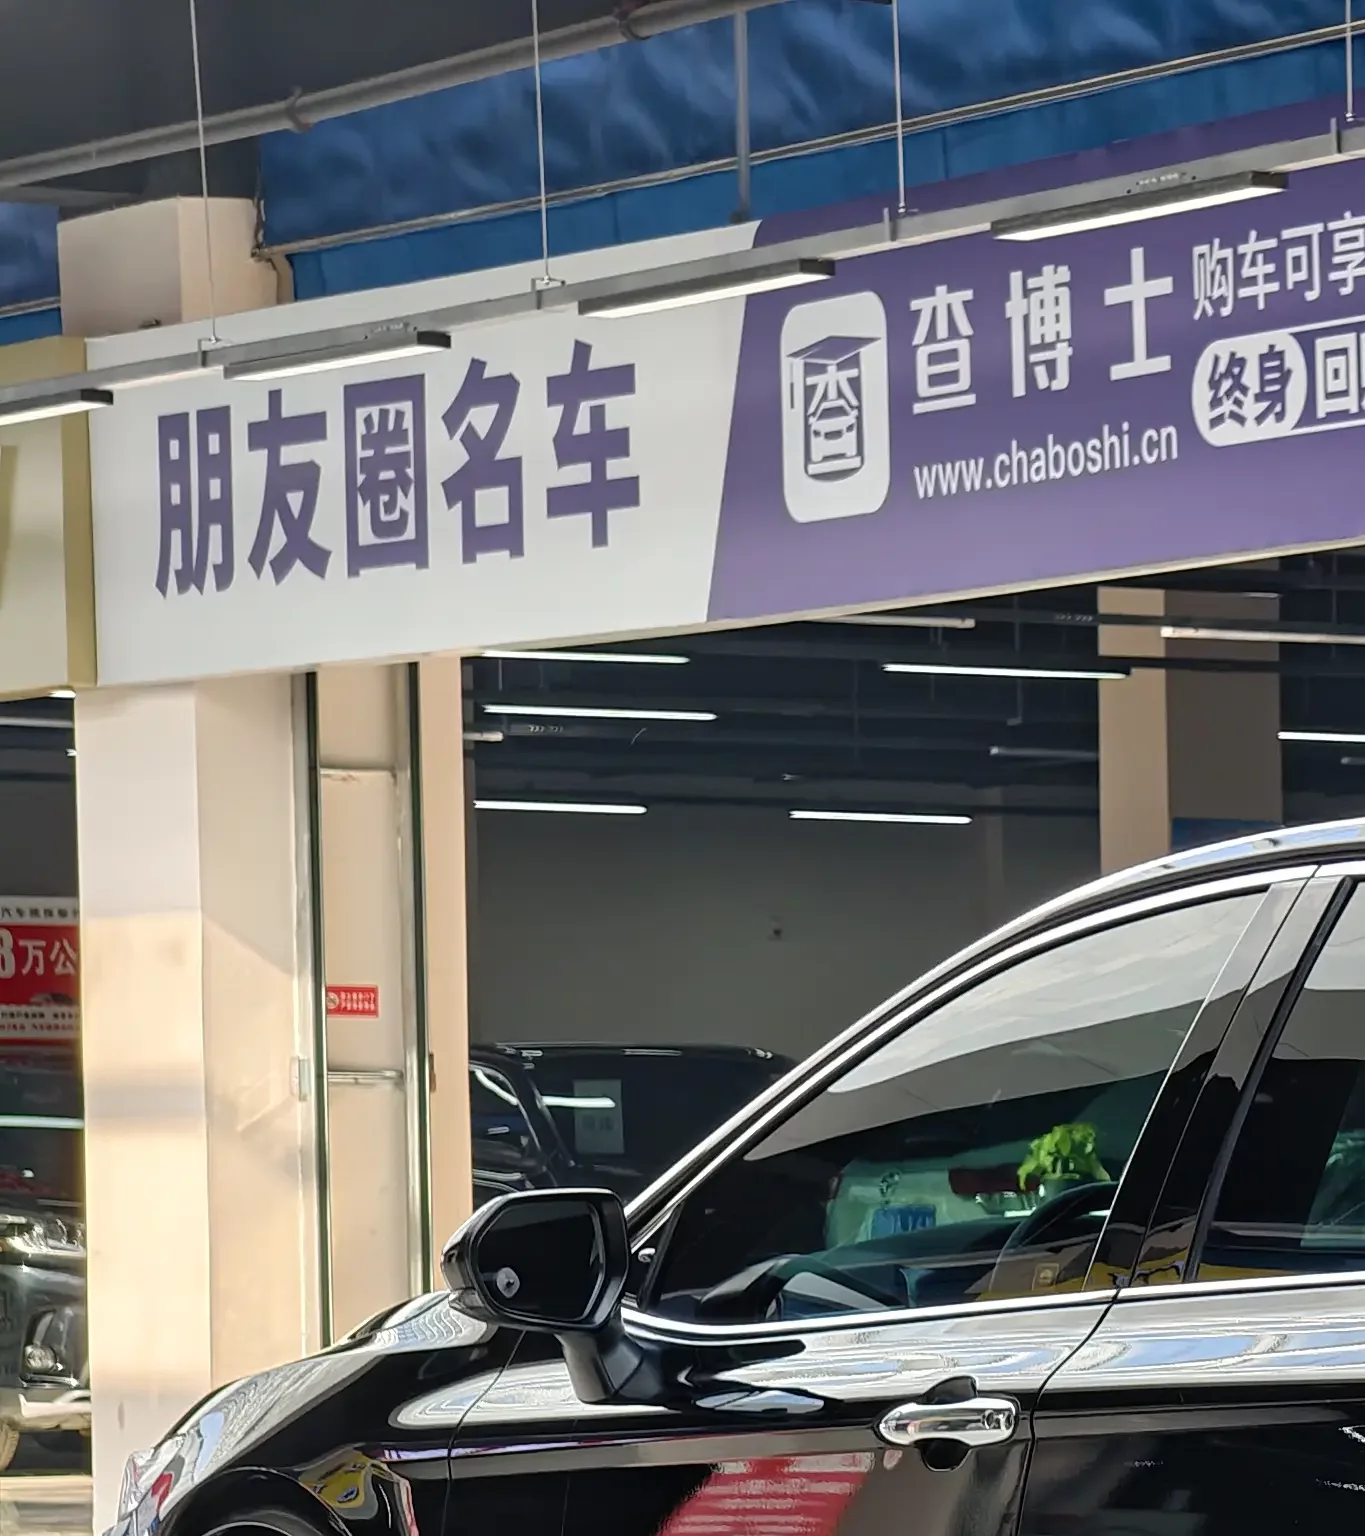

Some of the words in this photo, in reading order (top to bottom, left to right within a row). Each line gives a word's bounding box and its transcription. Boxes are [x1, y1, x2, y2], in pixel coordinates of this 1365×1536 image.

[910, 247, 1173, 415] 查博士
[1209, 344, 1292, 431] 终身
[155, 340, 640, 597] 朋友圈名车
[914, 421, 1178, 499] www.chaboshi.cn
